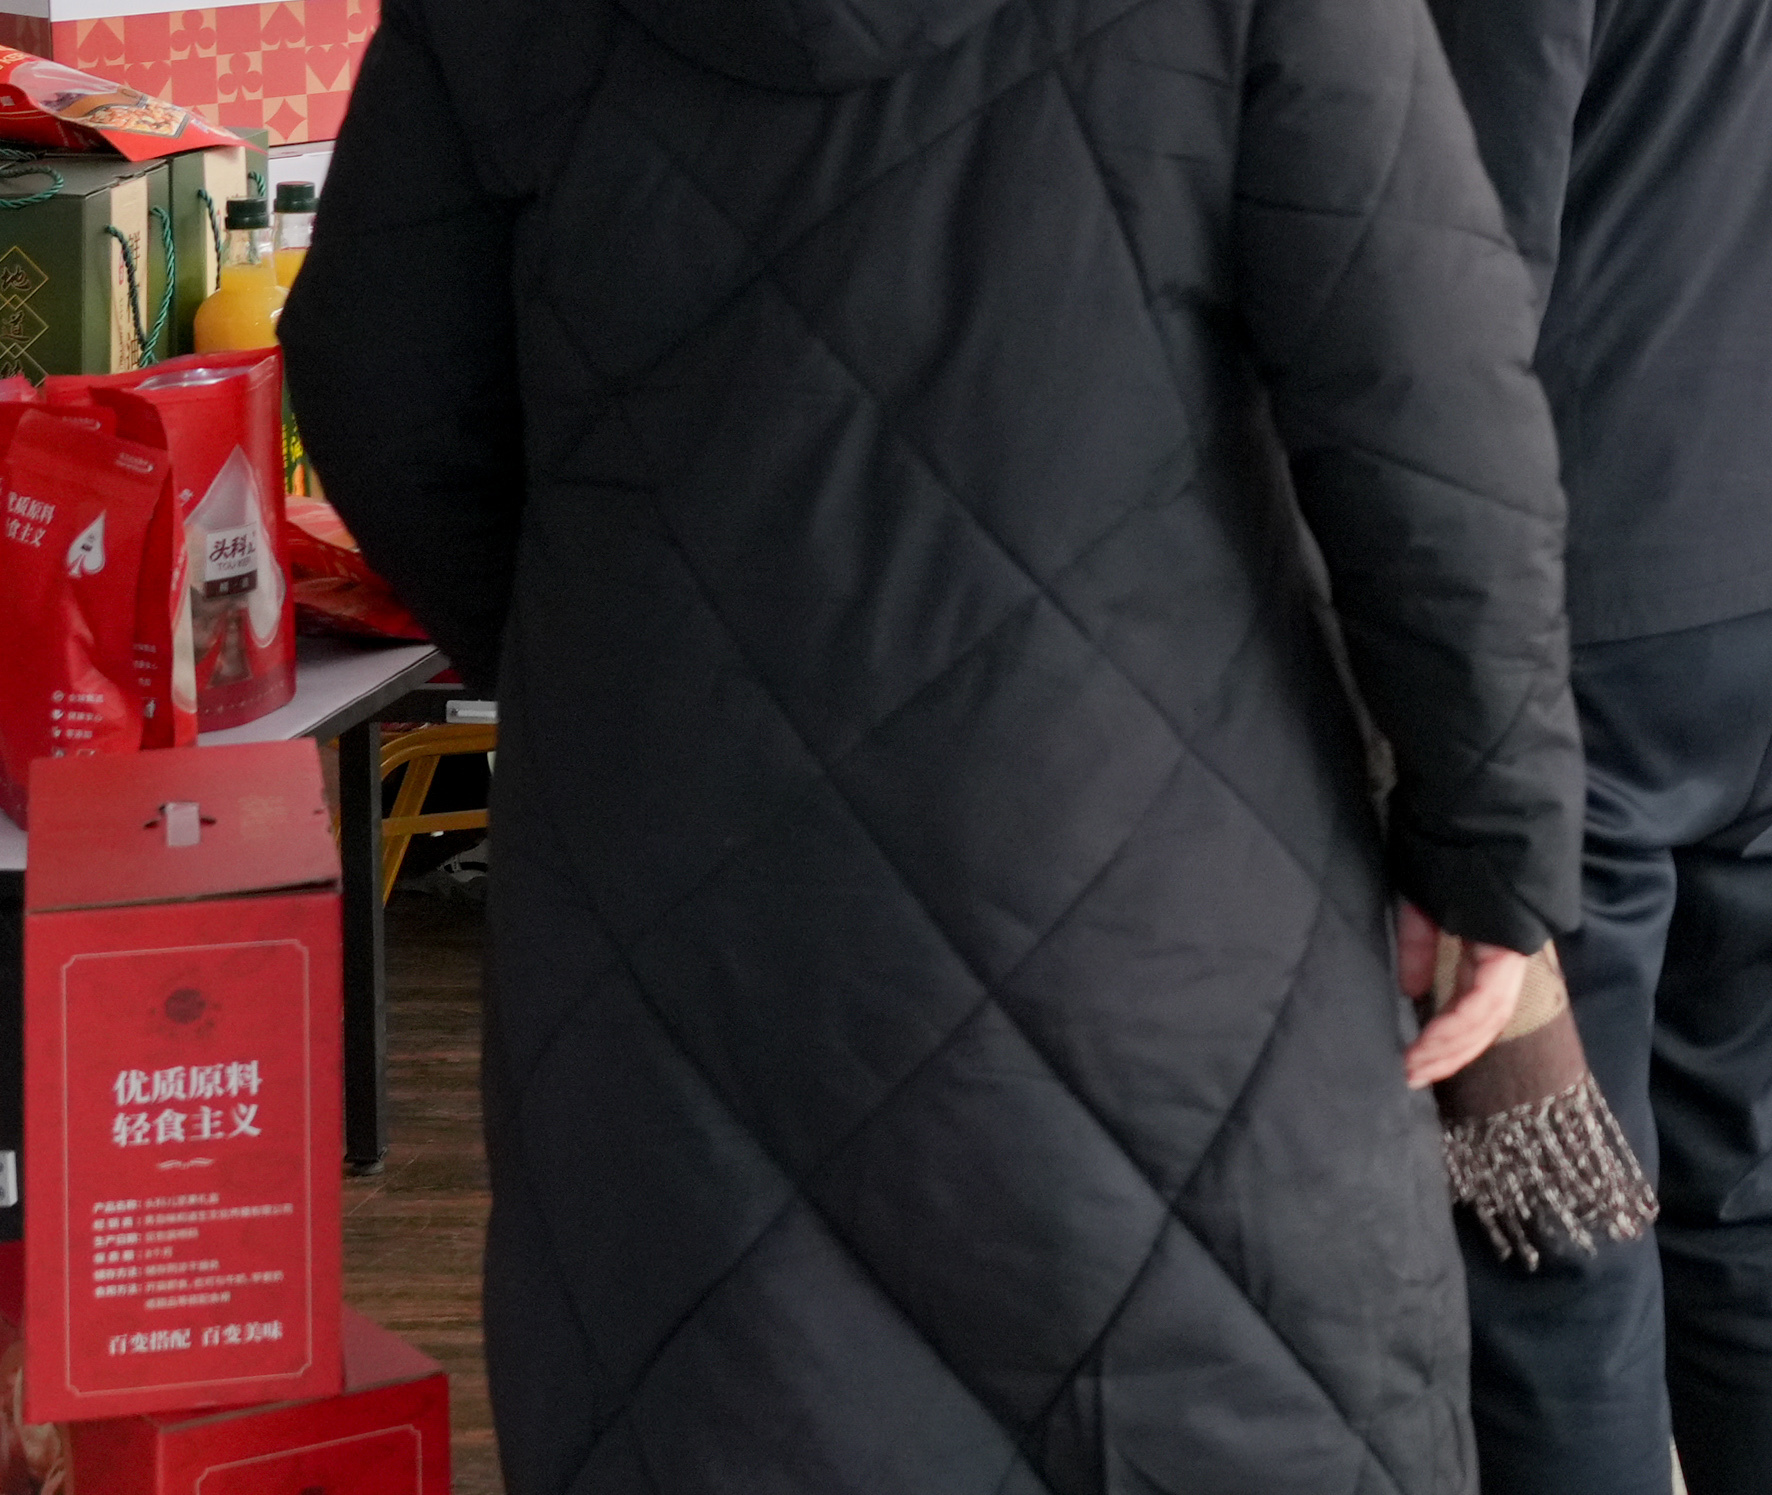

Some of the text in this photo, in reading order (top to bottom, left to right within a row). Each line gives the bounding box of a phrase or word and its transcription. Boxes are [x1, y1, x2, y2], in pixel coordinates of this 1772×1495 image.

[112, 1060, 263, 1106] 优质原料
[112, 1104, 262, 1147] 轻食主义
[109, 1320, 284, 1355] 百变搭配 百变美味
